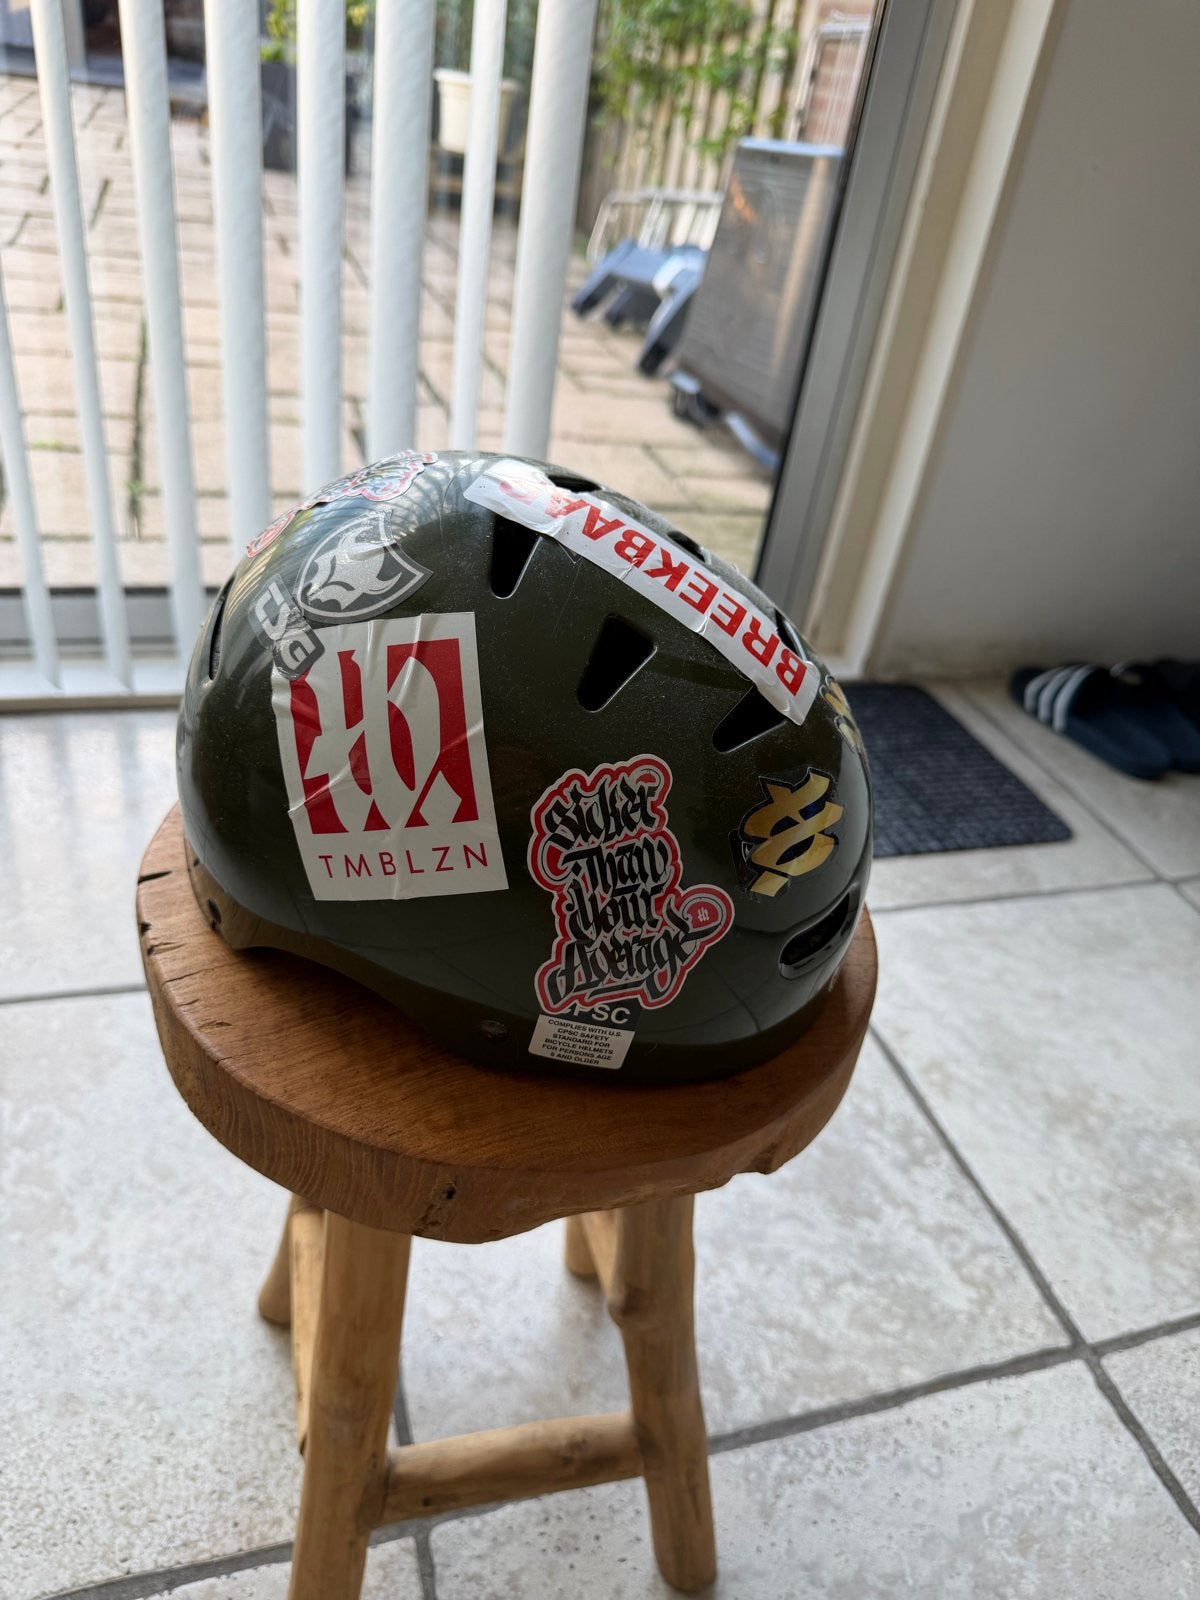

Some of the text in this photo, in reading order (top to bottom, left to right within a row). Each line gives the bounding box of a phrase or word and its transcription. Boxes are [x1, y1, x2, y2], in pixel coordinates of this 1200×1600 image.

[318, 842, 489, 879] TMBLZN
[562, 838, 669, 896] Than
[566, 879, 665, 946] Your
[548, 1019, 623, 1038] COMPLIES WITH U.S.
[557, 1028, 610, 1041] CPSC SAFETY
[544, 1038, 614, 1055] BICYCLE HELMETS
[552, 1033, 593, 1045] STANDARD
[555, 1053, 573, 1061] AND
[573, 1057, 600, 1065] OLDER
[559, 1047, 595, 1058] PERSONS
